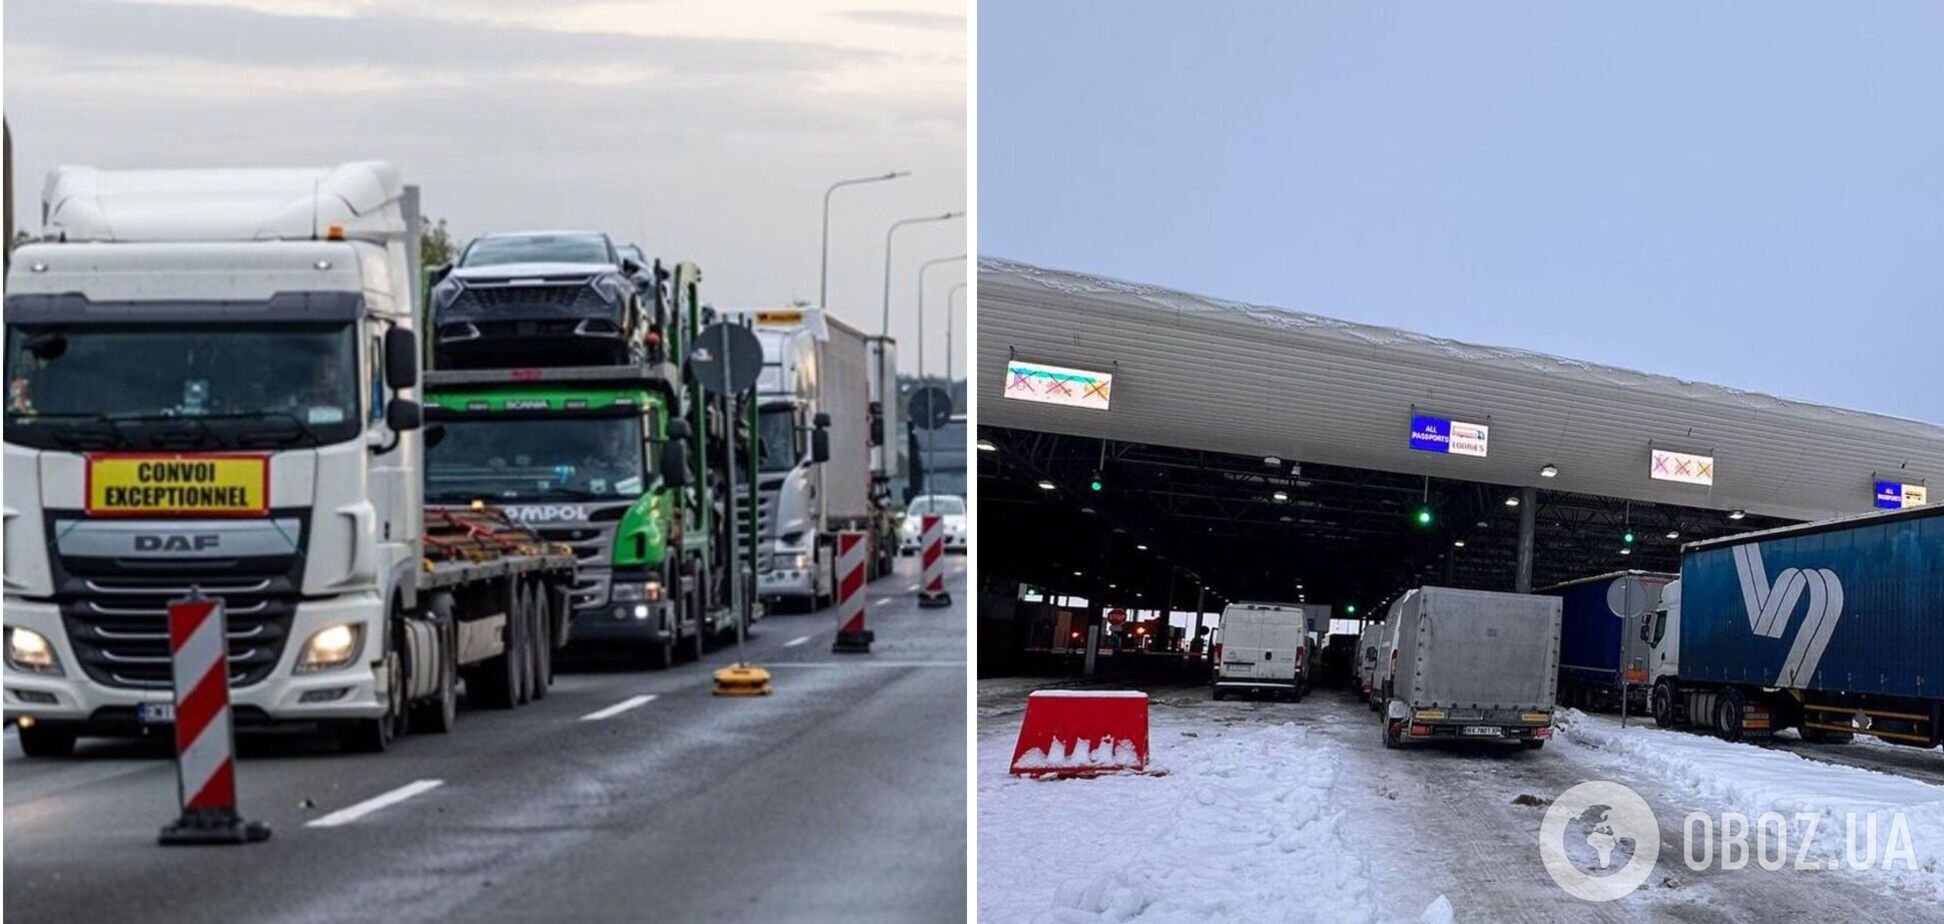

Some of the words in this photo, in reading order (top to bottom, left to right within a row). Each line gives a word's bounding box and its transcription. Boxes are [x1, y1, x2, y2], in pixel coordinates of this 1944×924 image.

[1412, 431, 1449, 443] PASSPORTS
[1425, 425, 1437, 433] ALL
[138, 462, 215, 483] CONVOI
[105, 487, 248, 507] EXCEPTIONNEL
[134, 535, 219, 551] DAF
